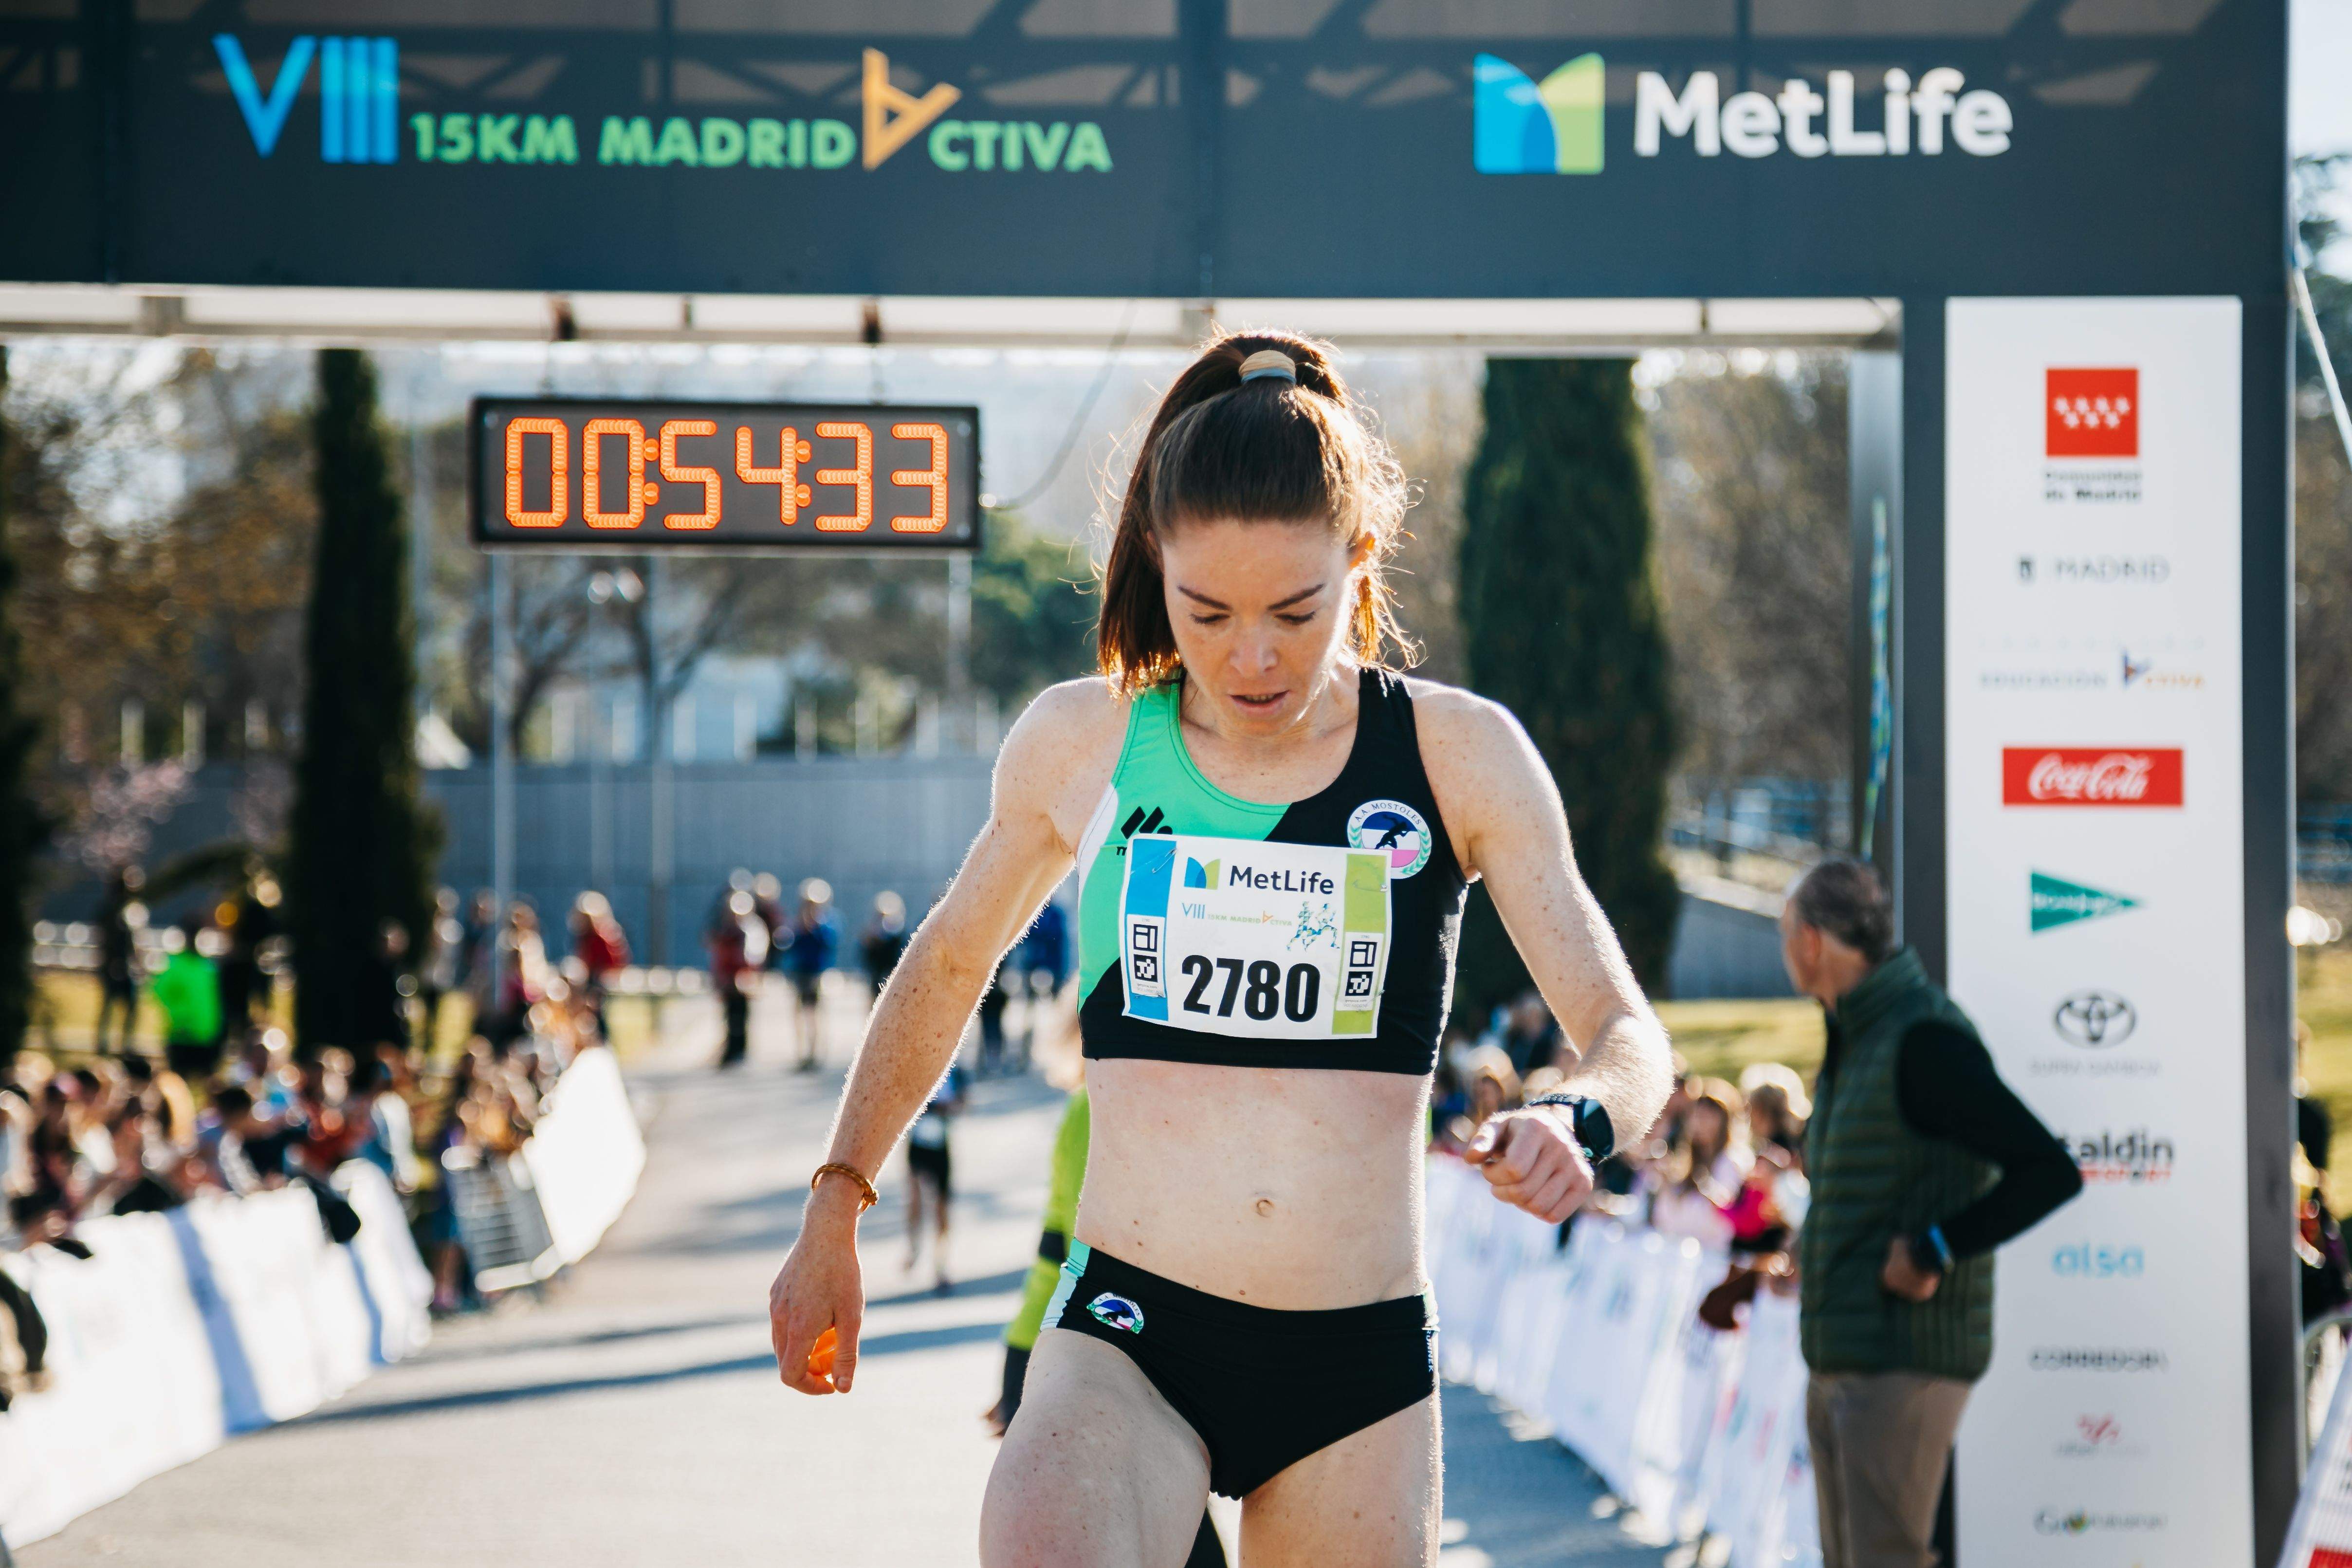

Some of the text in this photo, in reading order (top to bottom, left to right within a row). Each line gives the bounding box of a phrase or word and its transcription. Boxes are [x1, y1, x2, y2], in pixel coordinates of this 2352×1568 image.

[213, 34, 400, 165] VIII
[409, 112, 578, 164] 15KM
[1633, 66, 2014, 158] MetLife
[505, 417, 948, 533] 00:54:33
[2055, 556, 2170, 584] MADRID
[2027, 752, 2156, 800] Coca-Cola
[1371, 803, 1422, 825] MOSTOLES
[1229, 865, 1334, 895] MetLife
[1181, 903, 1206, 920] VIII
[1181, 954, 1321, 1023] 2780
[2051, 1241, 2145, 1278] alsa
